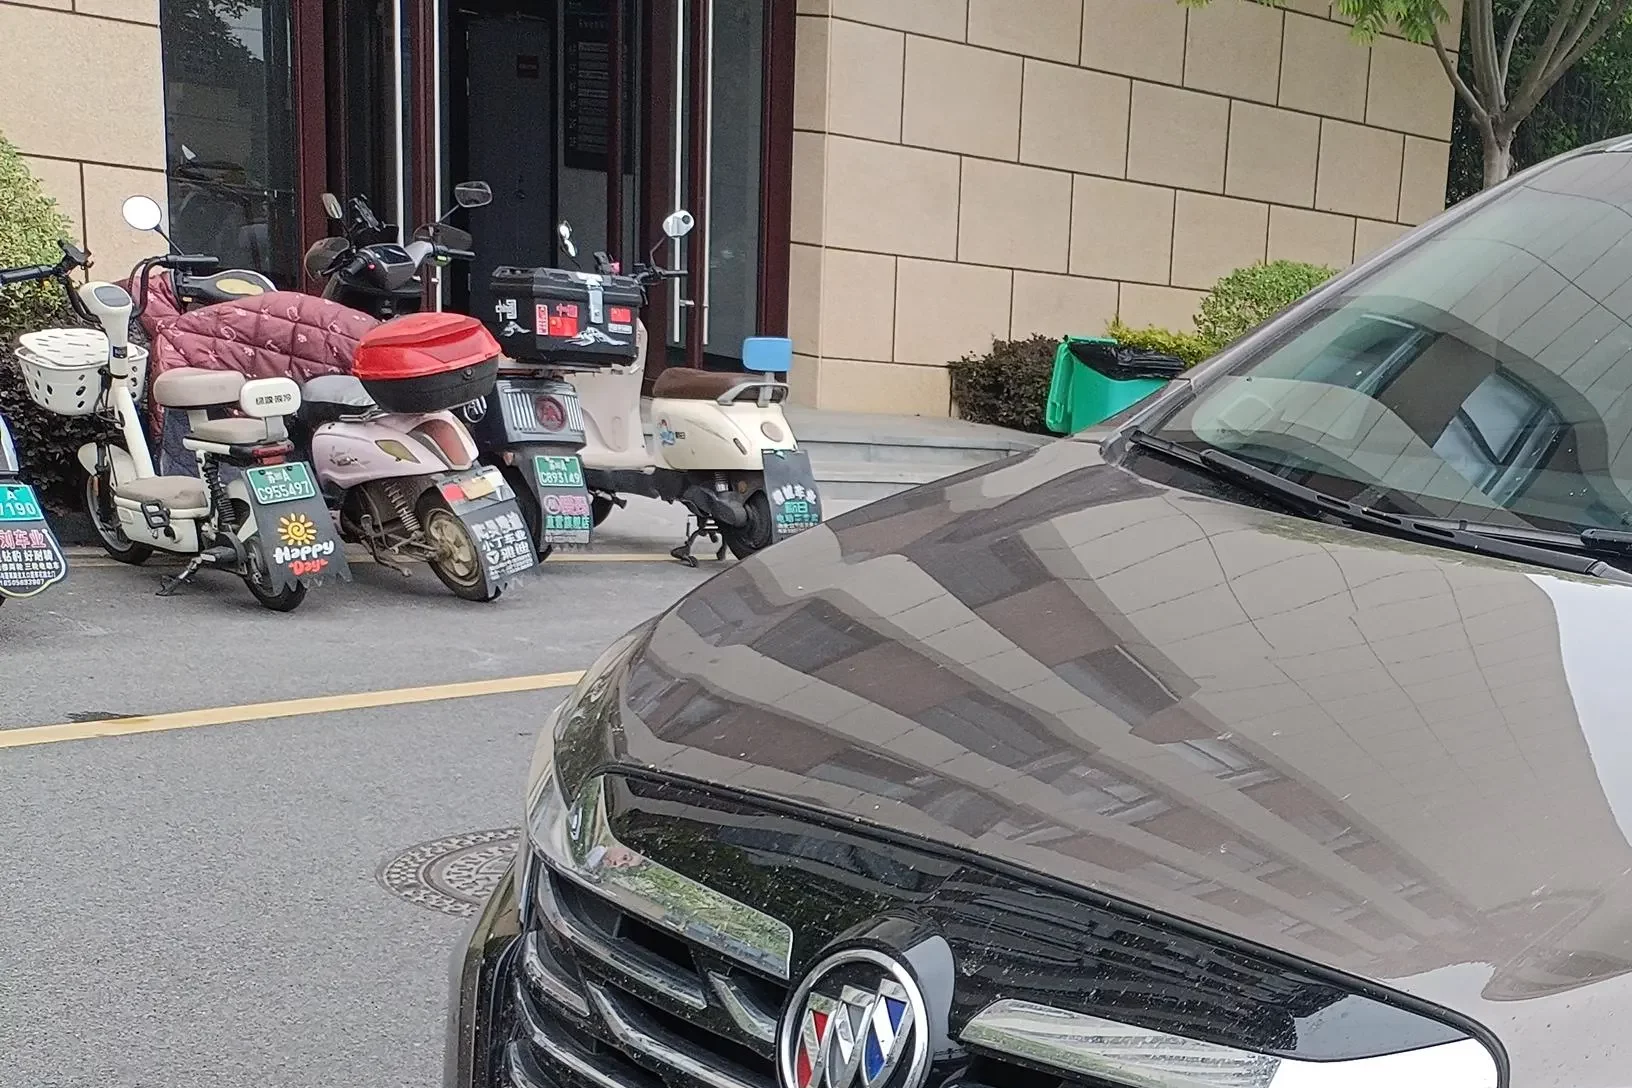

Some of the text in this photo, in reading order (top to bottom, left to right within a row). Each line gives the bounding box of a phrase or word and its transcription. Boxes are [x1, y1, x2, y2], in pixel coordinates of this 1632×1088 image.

[257, 481, 311, 501] C955497
[273, 540, 335, 565] Happy
[288, 558, 328, 575] Day
